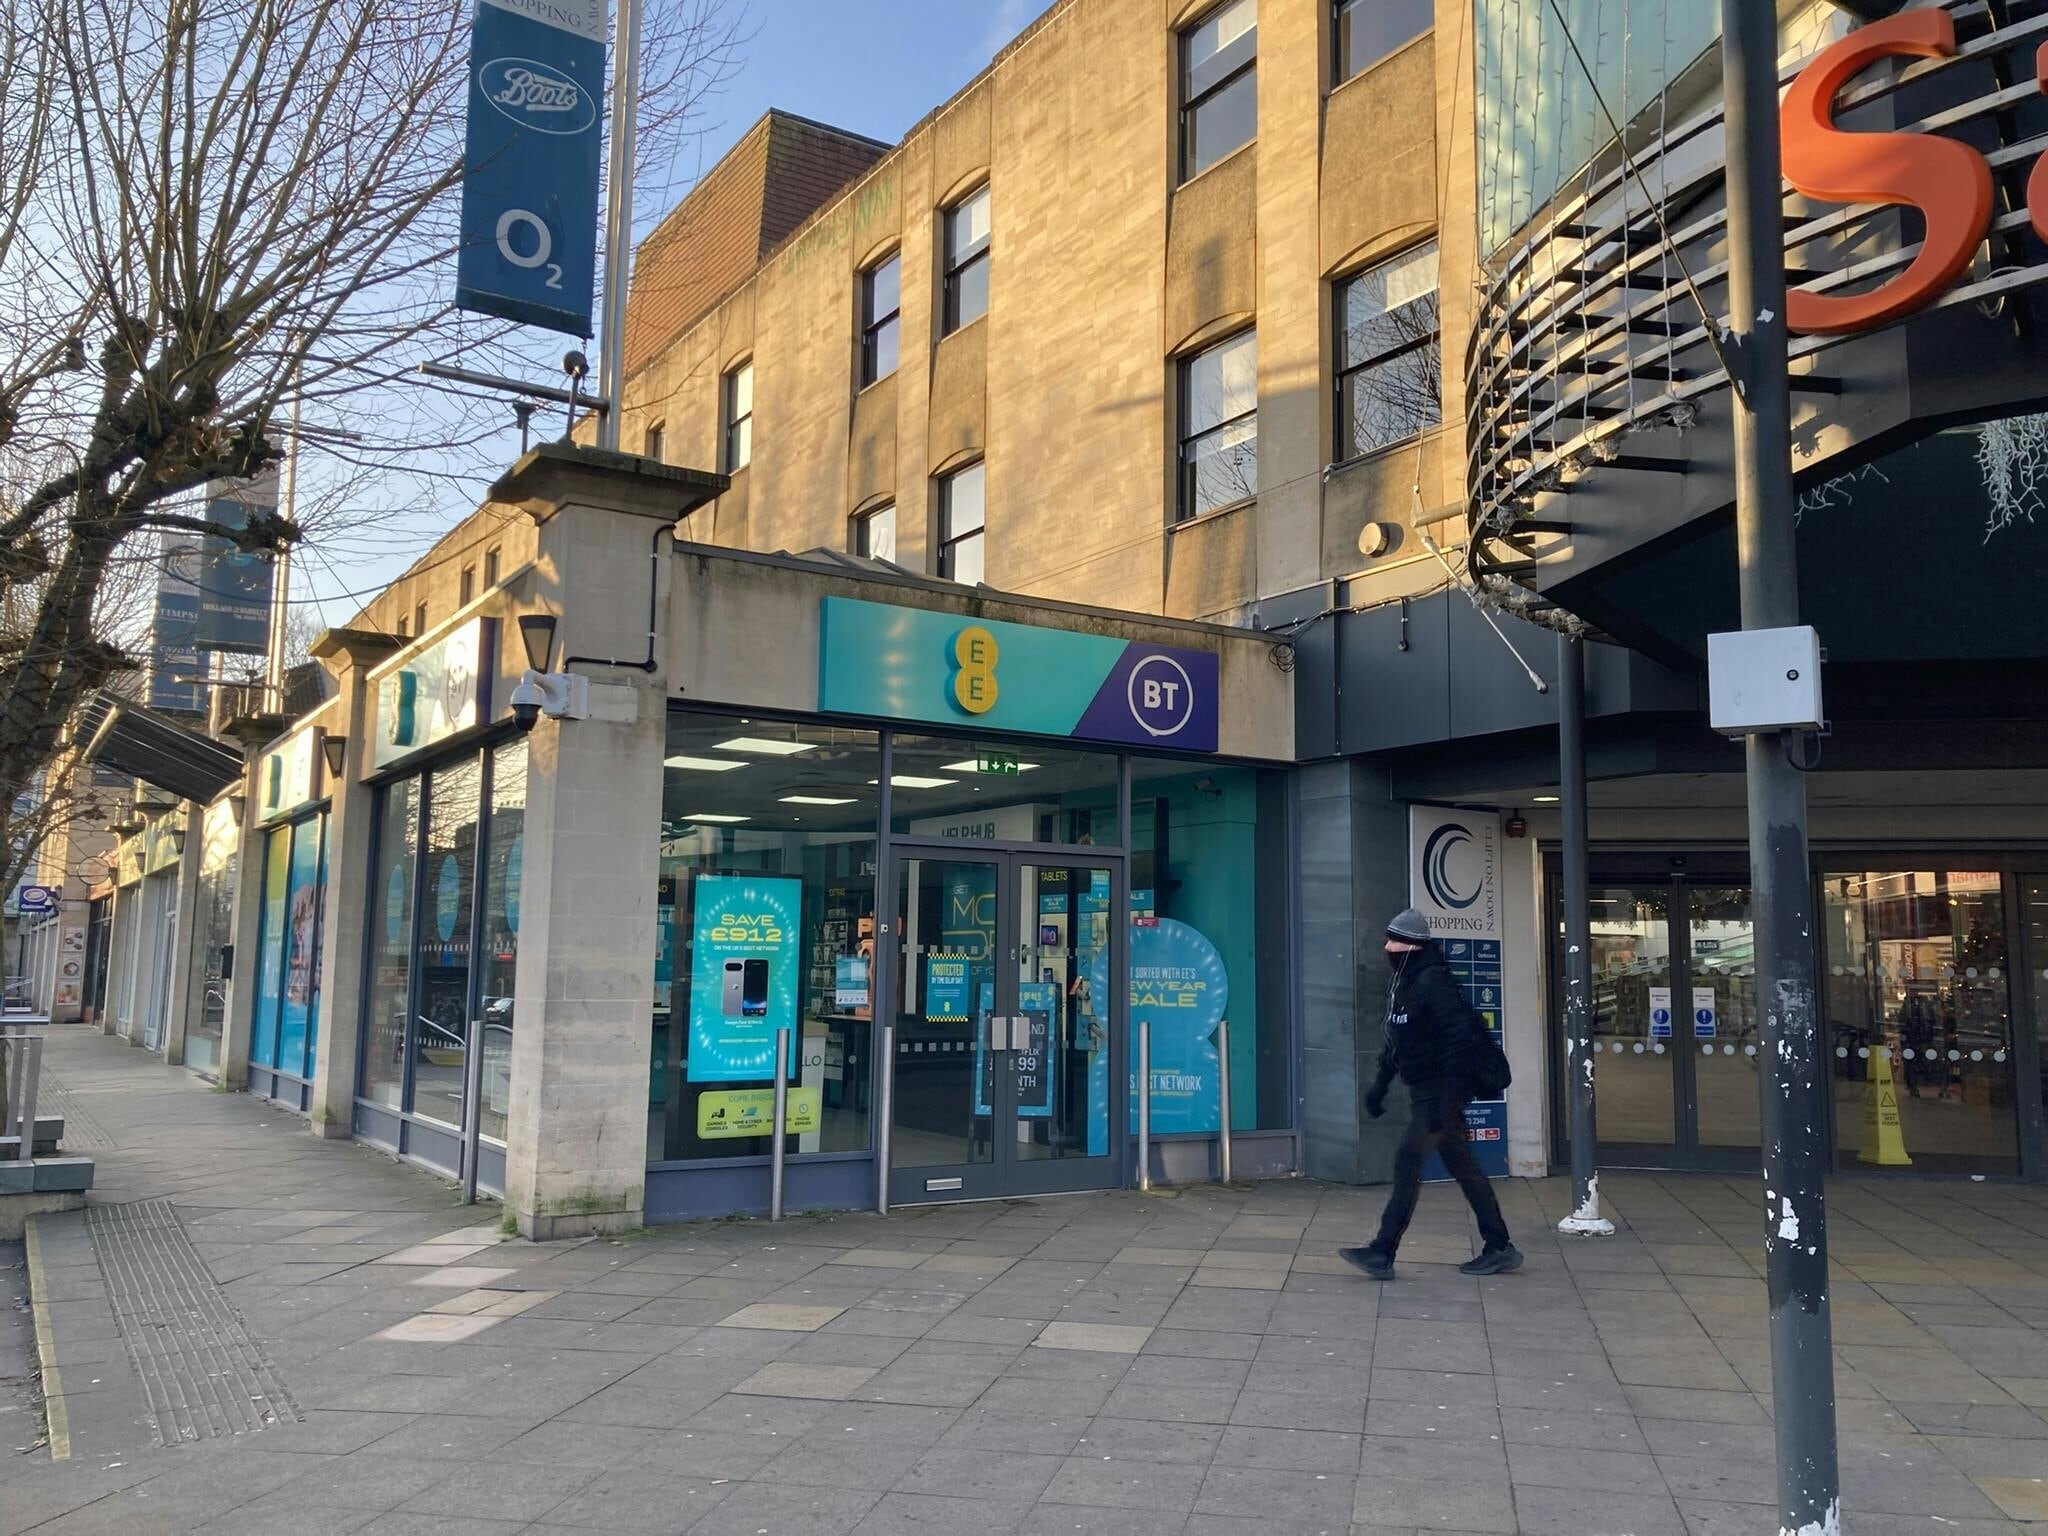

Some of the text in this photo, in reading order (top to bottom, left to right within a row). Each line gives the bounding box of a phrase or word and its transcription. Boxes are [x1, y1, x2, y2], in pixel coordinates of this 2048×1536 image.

[493, 67, 578, 111] Boots
[495, 208, 562, 290] O2
[1144, 679, 1179, 711] BT
[1041, 870, 1068, 881] TABLETS
[1484, 826, 1495, 932] CLIFTON DOWN
[1129, 892, 1145, 900] ALE
[721, 914, 775, 926] SAVE
[710, 927, 783, 943] £912
[1135, 967, 1161, 979] SORTED
[1162, 968, 1181, 980] WITH
[1181, 969, 1197, 980] EE'S
[1130, 981, 1207, 992] EW YEAR
[1018, 1075, 1037, 1088] NTH
[1160, 1075, 1202, 1091] NETWORK
